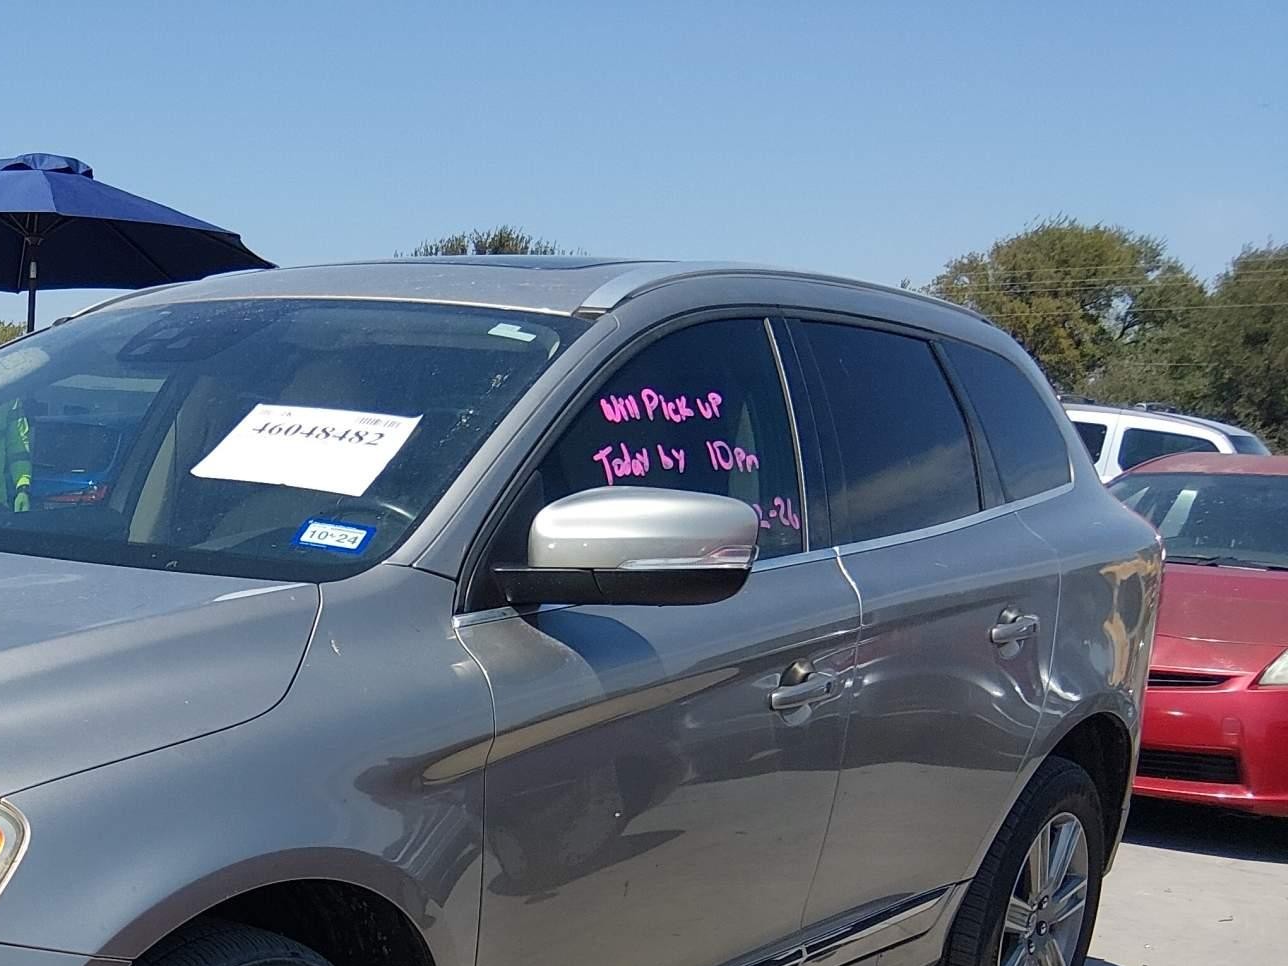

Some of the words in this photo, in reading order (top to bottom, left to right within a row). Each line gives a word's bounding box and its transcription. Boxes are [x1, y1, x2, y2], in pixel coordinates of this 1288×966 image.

[251, 420, 386, 447] 46048482
[592, 442, 650, 486] Today
[656, 444, 685, 474] by
